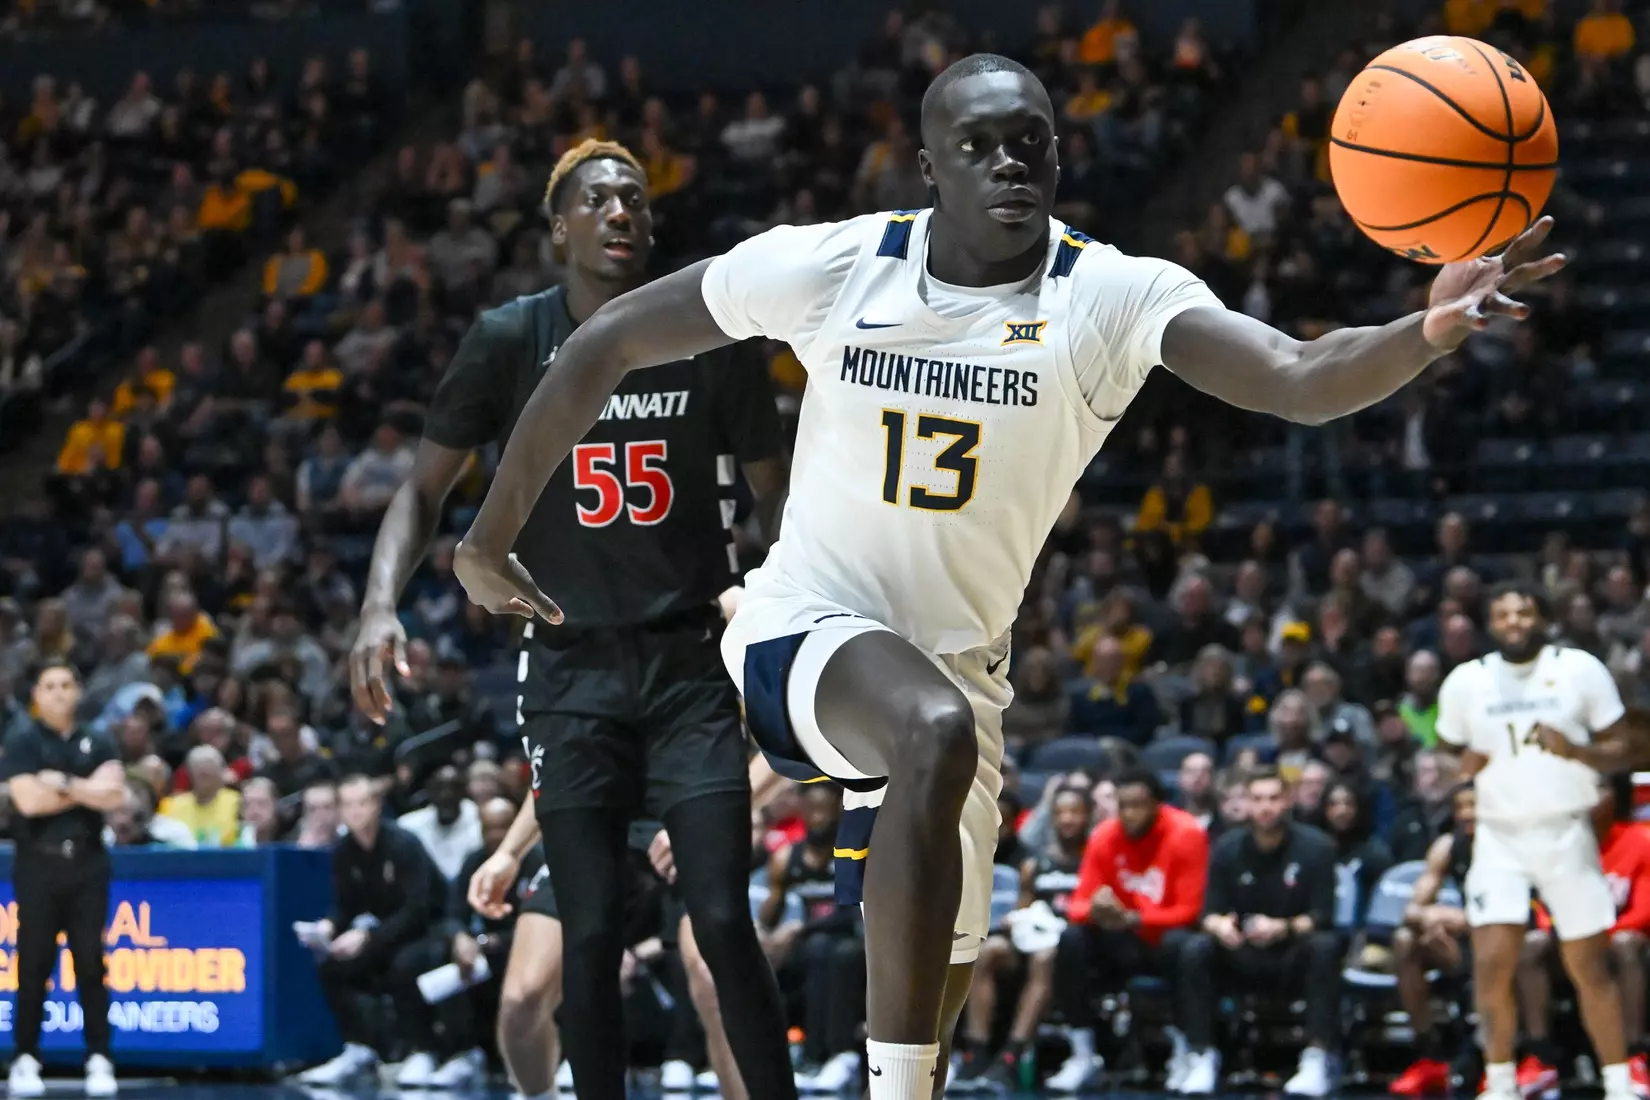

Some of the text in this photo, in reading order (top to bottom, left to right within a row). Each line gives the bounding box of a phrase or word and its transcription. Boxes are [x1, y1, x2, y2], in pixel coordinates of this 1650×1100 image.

[840, 345, 1038, 407] MOUNTAINEERS
[572, 440, 675, 528] 55
[880, 408, 983, 512] 13
